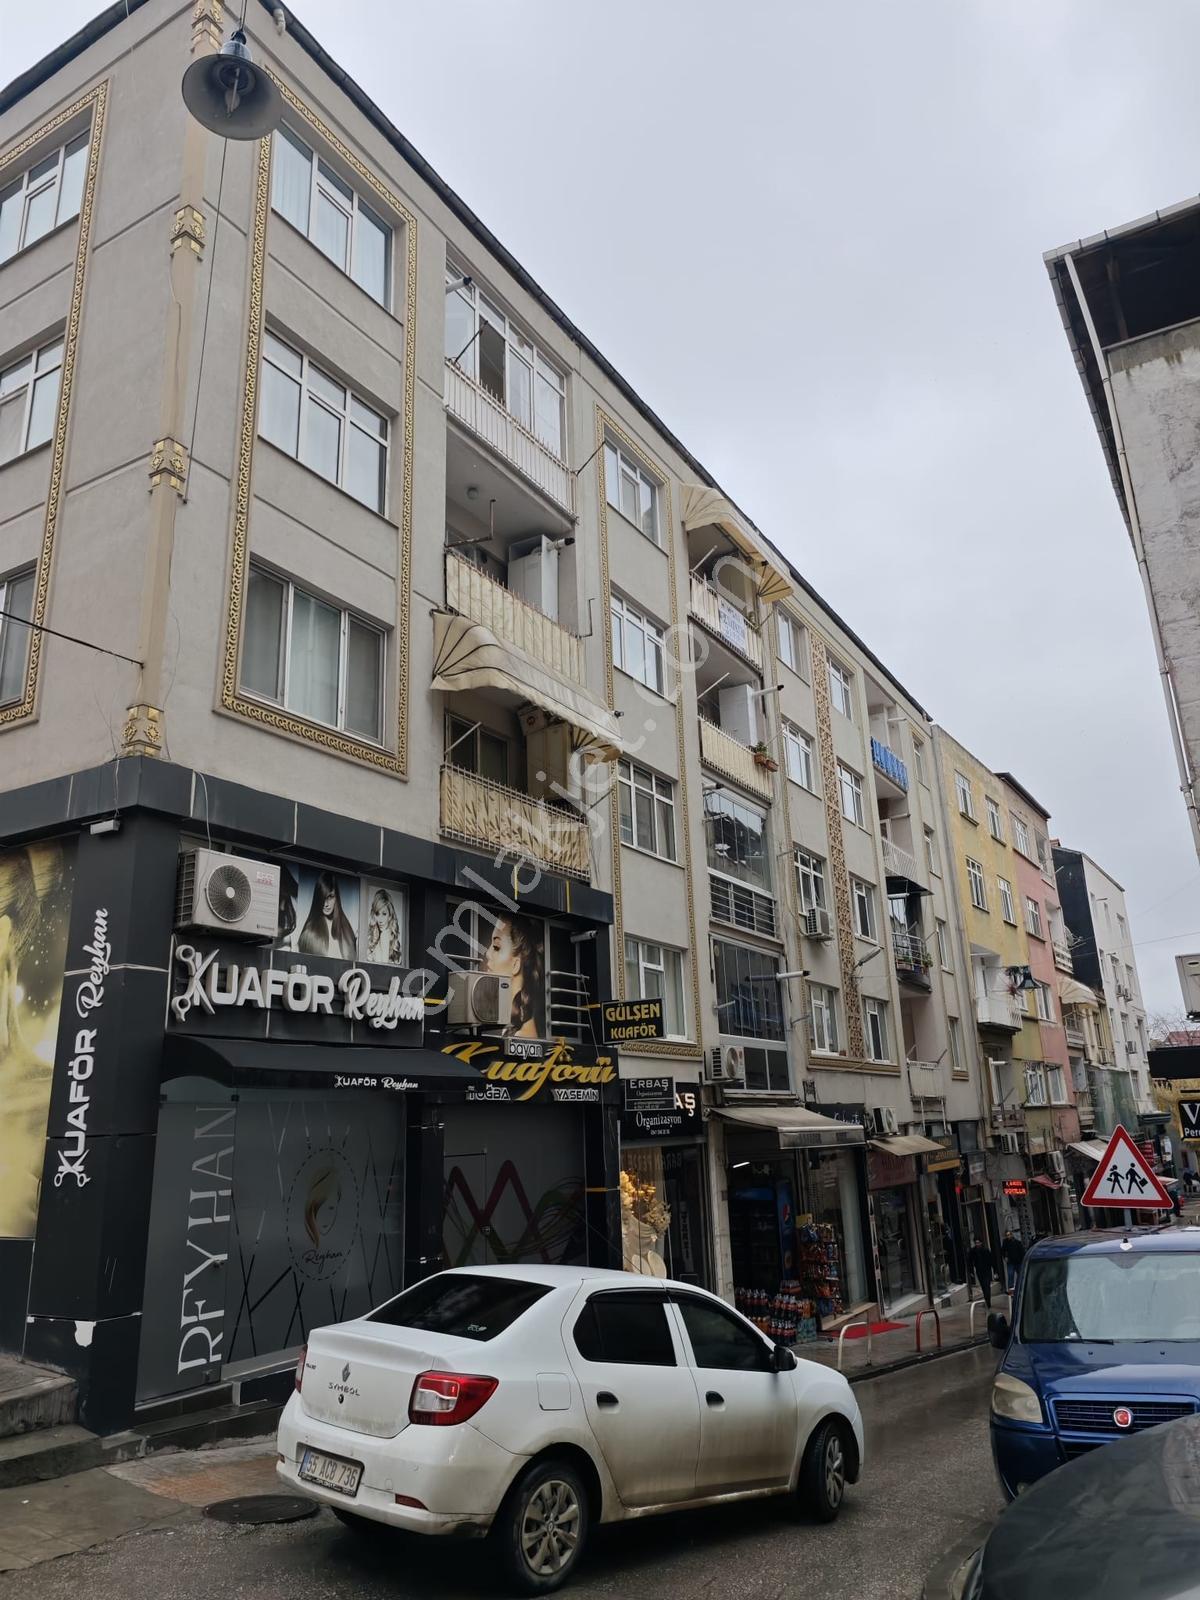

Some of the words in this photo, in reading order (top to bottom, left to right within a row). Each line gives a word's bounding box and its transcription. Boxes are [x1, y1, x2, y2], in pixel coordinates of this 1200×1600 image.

[172, 944, 334, 1022] KUAFÖR
[338, 968, 424, 1030] Reyhan
[605, 1003, 661, 1021] GÜLŞEN
[611, 1023, 657, 1039] KUAFÖR
[54, 1028, 97, 1188] KUAFÖR
[76, 907, 111, 1019] Reyhan
[508, 1041, 542, 1060] bayan
[334, 1075, 378, 1088] KUAFÖR
[381, 1077, 419, 1090] Reyhan
[629, 1079, 669, 1091] ERBAŞ
[636, 1111, 682, 1130] Organizasyon
[328, 1382, 361, 1397] SYMBOL
[319, 1459, 338, 1481] ACB
[337, 1464, 359, 1488] 736
